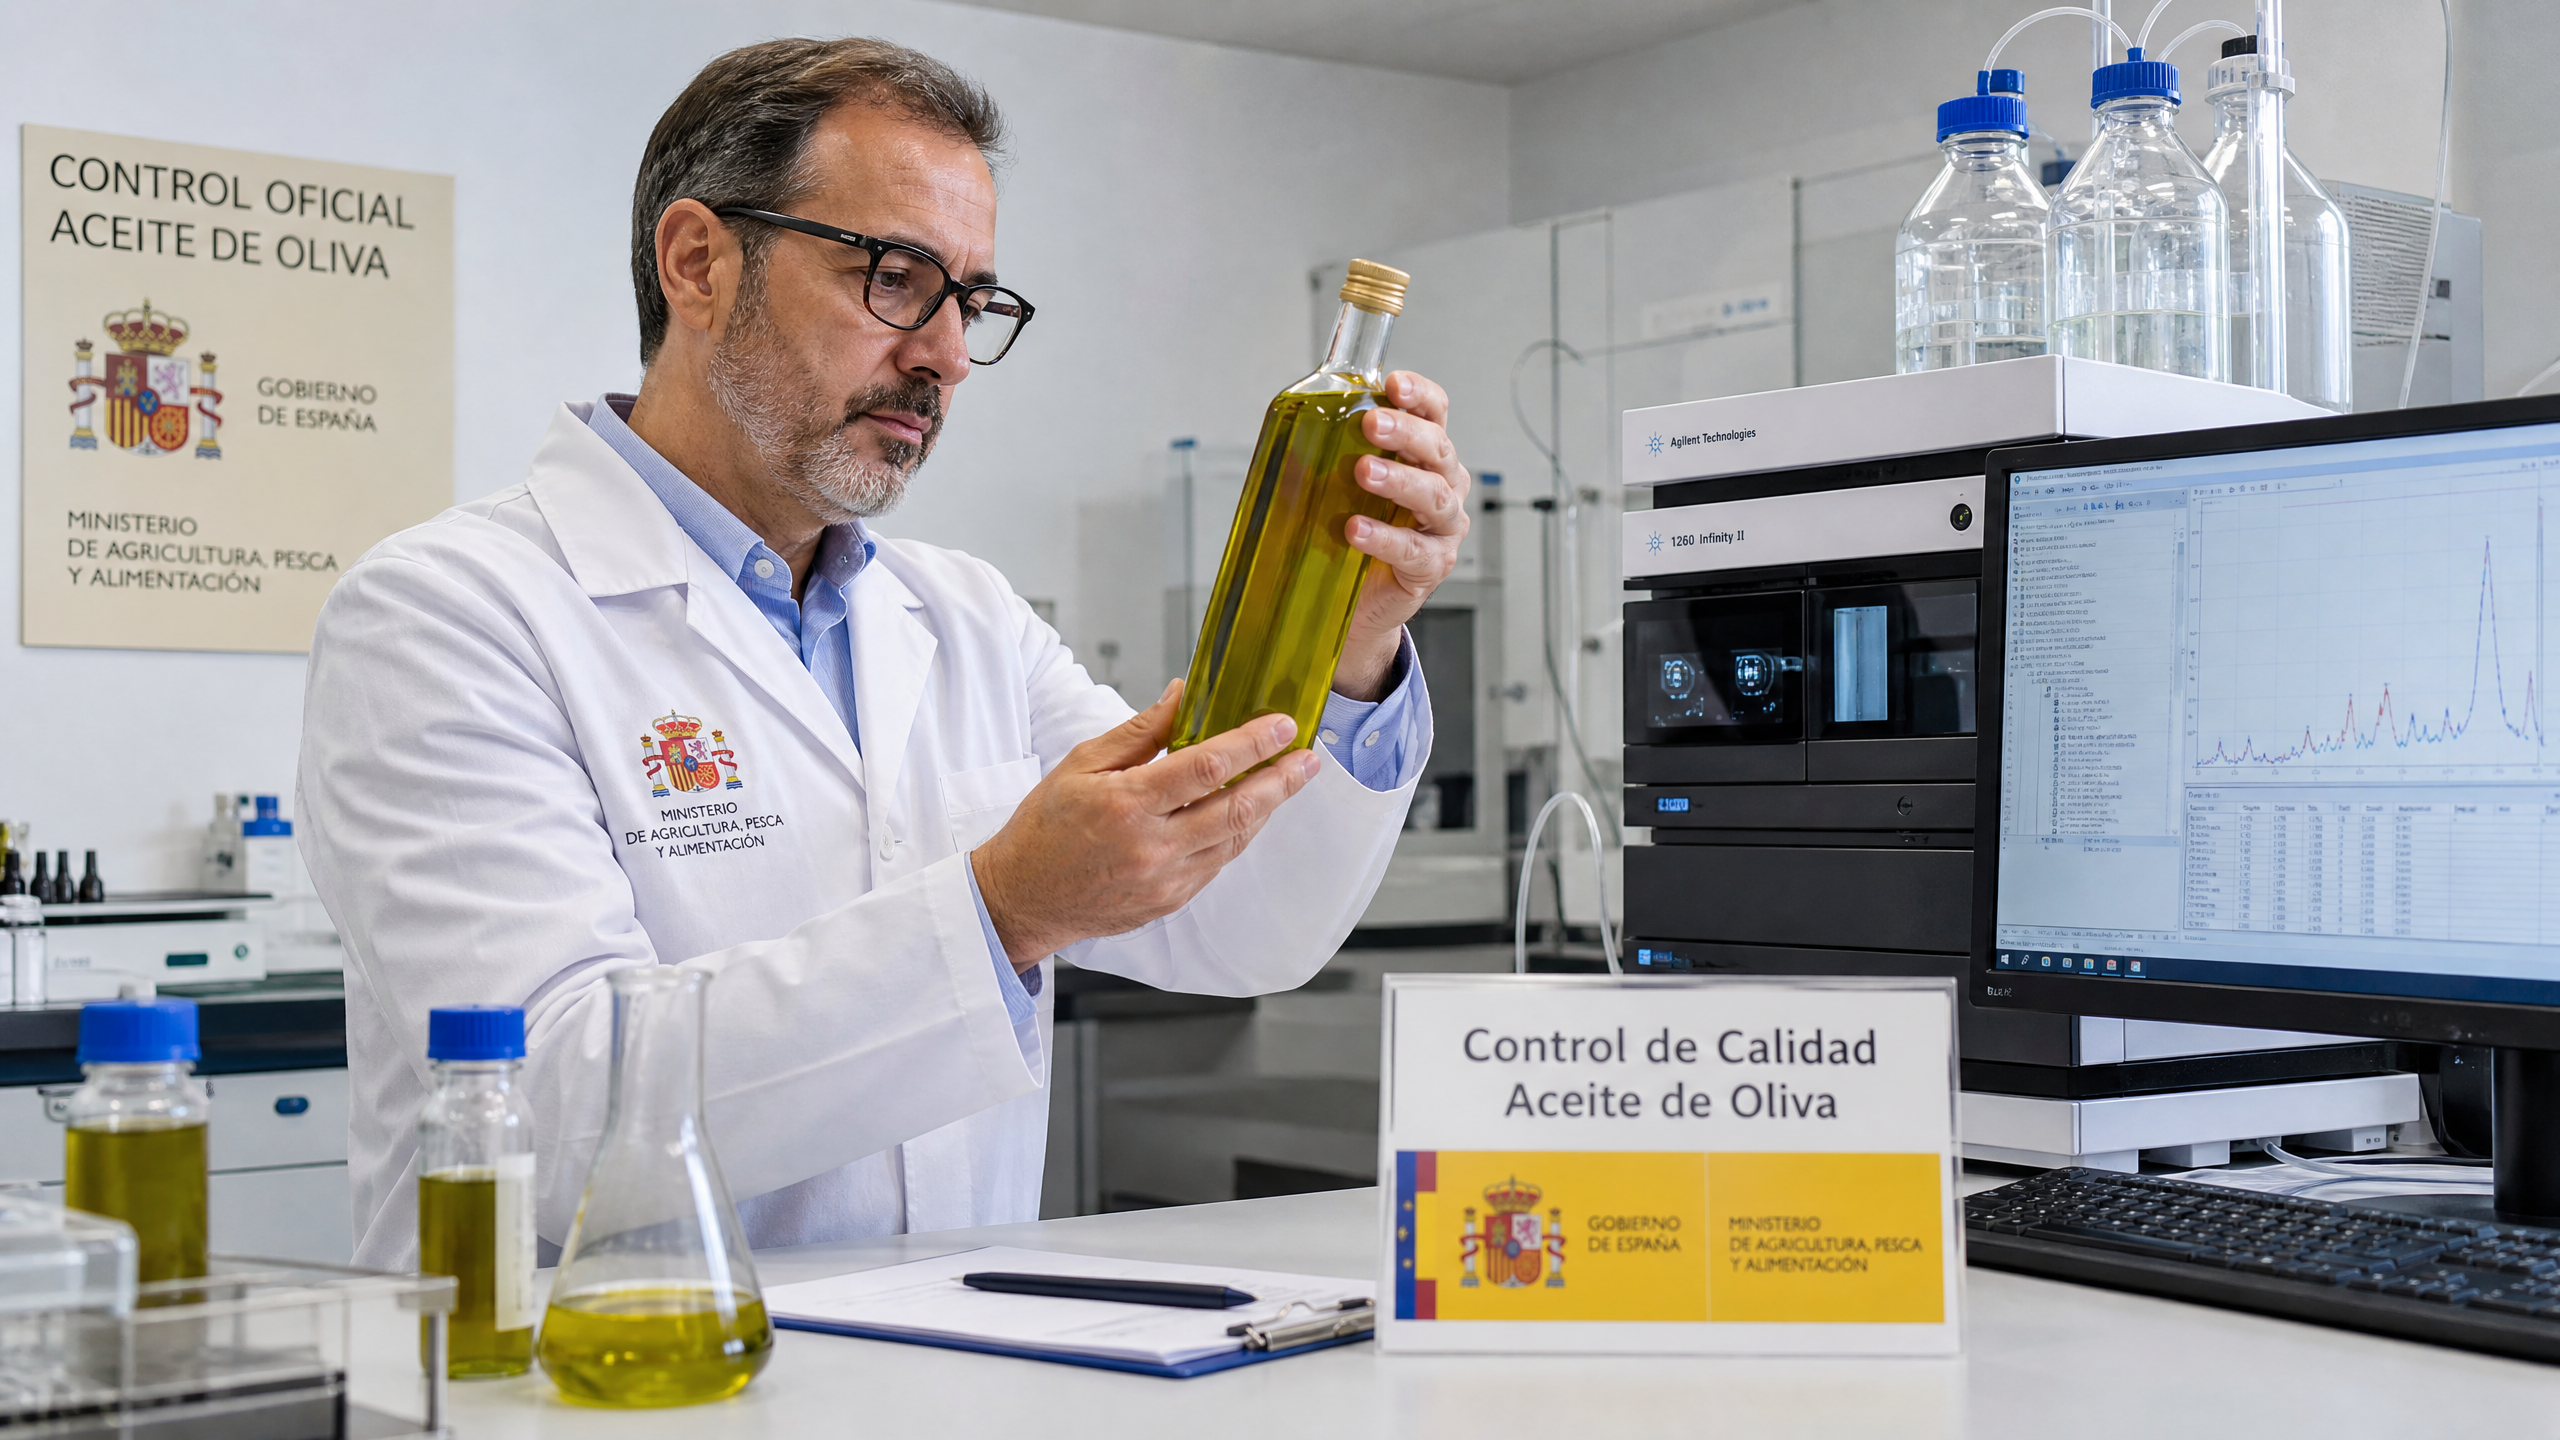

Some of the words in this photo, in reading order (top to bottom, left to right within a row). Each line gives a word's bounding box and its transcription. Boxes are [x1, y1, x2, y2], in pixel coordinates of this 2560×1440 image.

[51, 155, 250, 211] CONTROL
[266, 181, 413, 229] OFICIAL
[51, 210, 194, 257] ACEITE
[213, 228, 260, 264] DE
[277, 236, 388, 278] OLIVA
[256, 377, 378, 404] GOBIERNO
[257, 405, 286, 426] DE
[295, 409, 377, 431] ESPAÑA
[1671, 435, 1700, 448] Agilent
[1702, 428, 1756, 443] Technologies
[67, 511, 198, 535] MINISTERIO
[1672, 535, 1694, 547] 1260
[1700, 532, 1733, 544] Infinity
[67, 539, 99, 558] DE
[273, 550, 339, 571] PESCA
[68, 568, 83, 584] Y
[89, 569, 261, 592] ALIMENTACIÓN
[661, 802, 737, 821] MINISTERIO
[626, 831, 646, 845] DE
[745, 815, 784, 829] PESCA
[656, 846, 663, 858] Y
[668, 834, 764, 857] ALIMENTACIÓN
[1464, 1027, 1625, 1063] Control
[1647, 1028, 1696, 1063] de
[1718, 1029, 1875, 1064] Calidad
[1506, 1083, 1640, 1118] Aceite
[1662, 1082, 1710, 1118] de
[1731, 1083, 1836, 1118] Oliva
[1587, 1215, 1681, 1232] GOBIERNO
[1728, 1216, 1822, 1233] MINISTERIO
[1587, 1235, 1611, 1253] DE
[1616, 1234, 1681, 1253] ESPAÑA
[1729, 1236, 1751, 1253] DE
[1874, 1237, 1923, 1253] PESCA
[1729, 1257, 1741, 1271] Y
[1744, 1255, 1868, 1273] ALIMENTACIÓN
